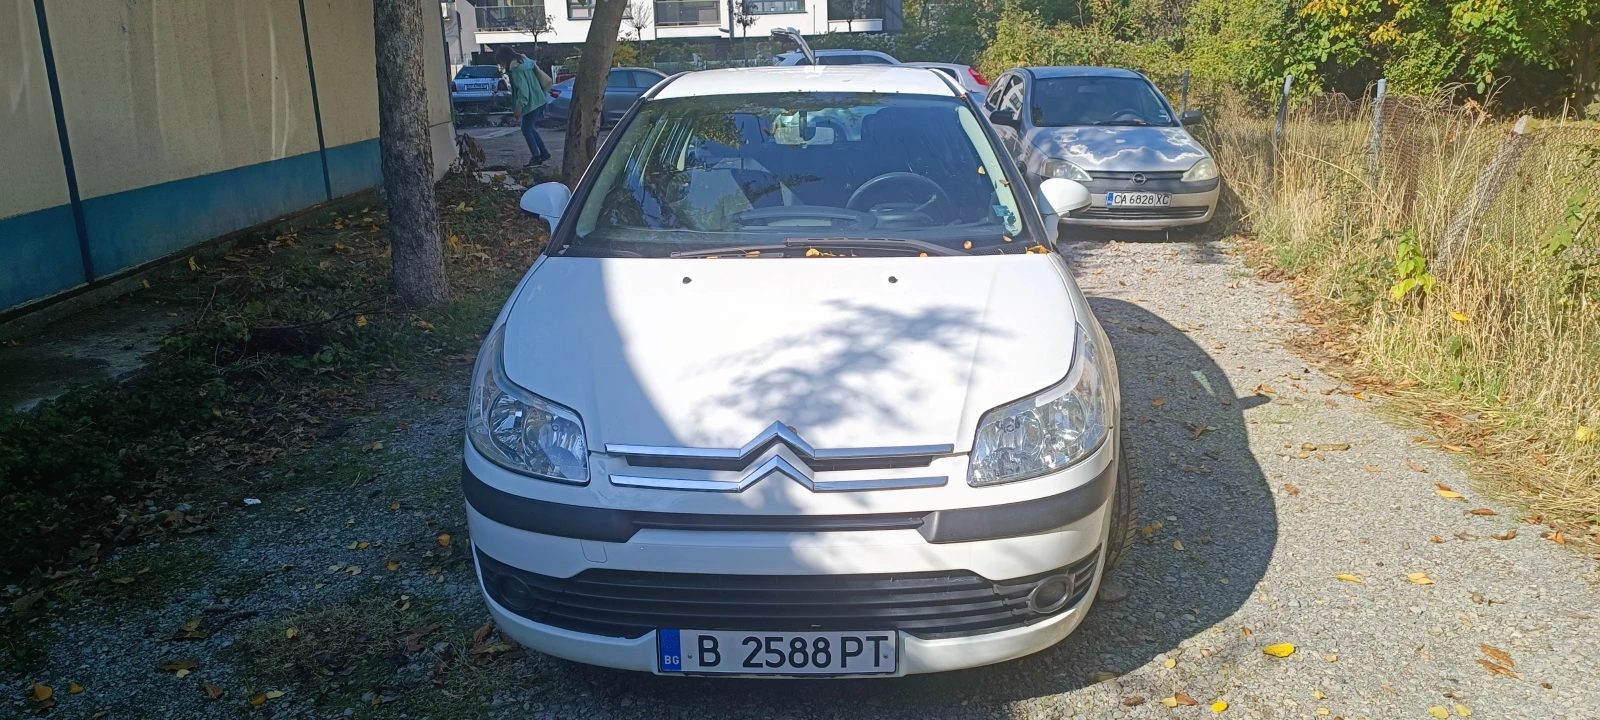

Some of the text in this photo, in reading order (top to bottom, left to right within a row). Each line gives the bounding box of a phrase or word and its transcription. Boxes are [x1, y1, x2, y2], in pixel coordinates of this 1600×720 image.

[1114, 194, 1127, 205] CA
[1129, 194, 1154, 205] 6828
[698, 635, 721, 667] B
[664, 655, 680, 665] BG
